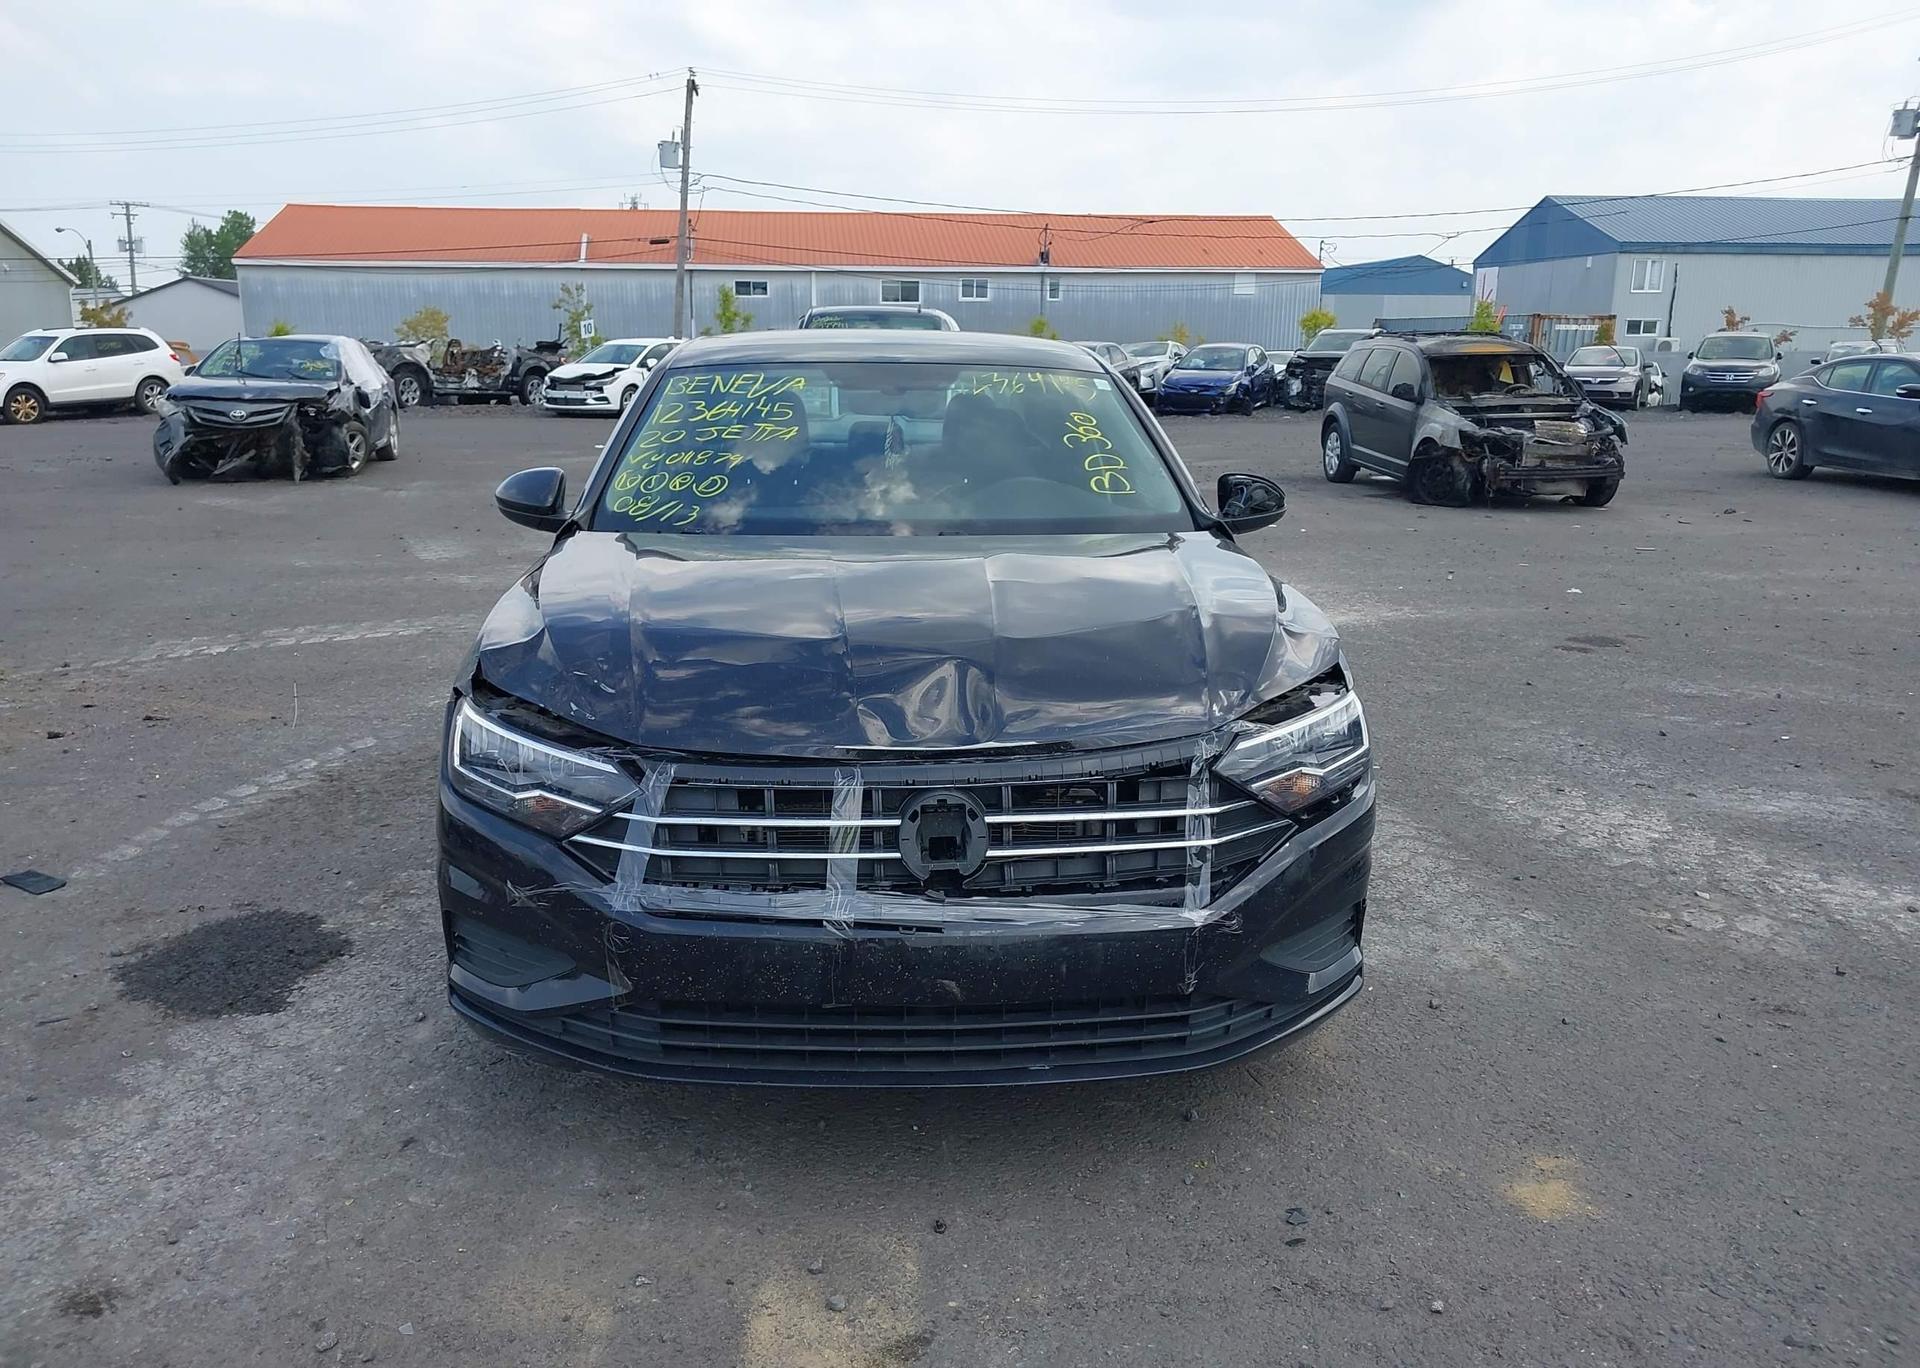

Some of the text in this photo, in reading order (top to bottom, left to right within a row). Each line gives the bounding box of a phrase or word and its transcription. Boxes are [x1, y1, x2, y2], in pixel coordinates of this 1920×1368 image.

[583, 322, 593, 335] 10
[640, 423, 799, 448] 20 JETTA
[1063, 412, 1136, 494] BD 360
